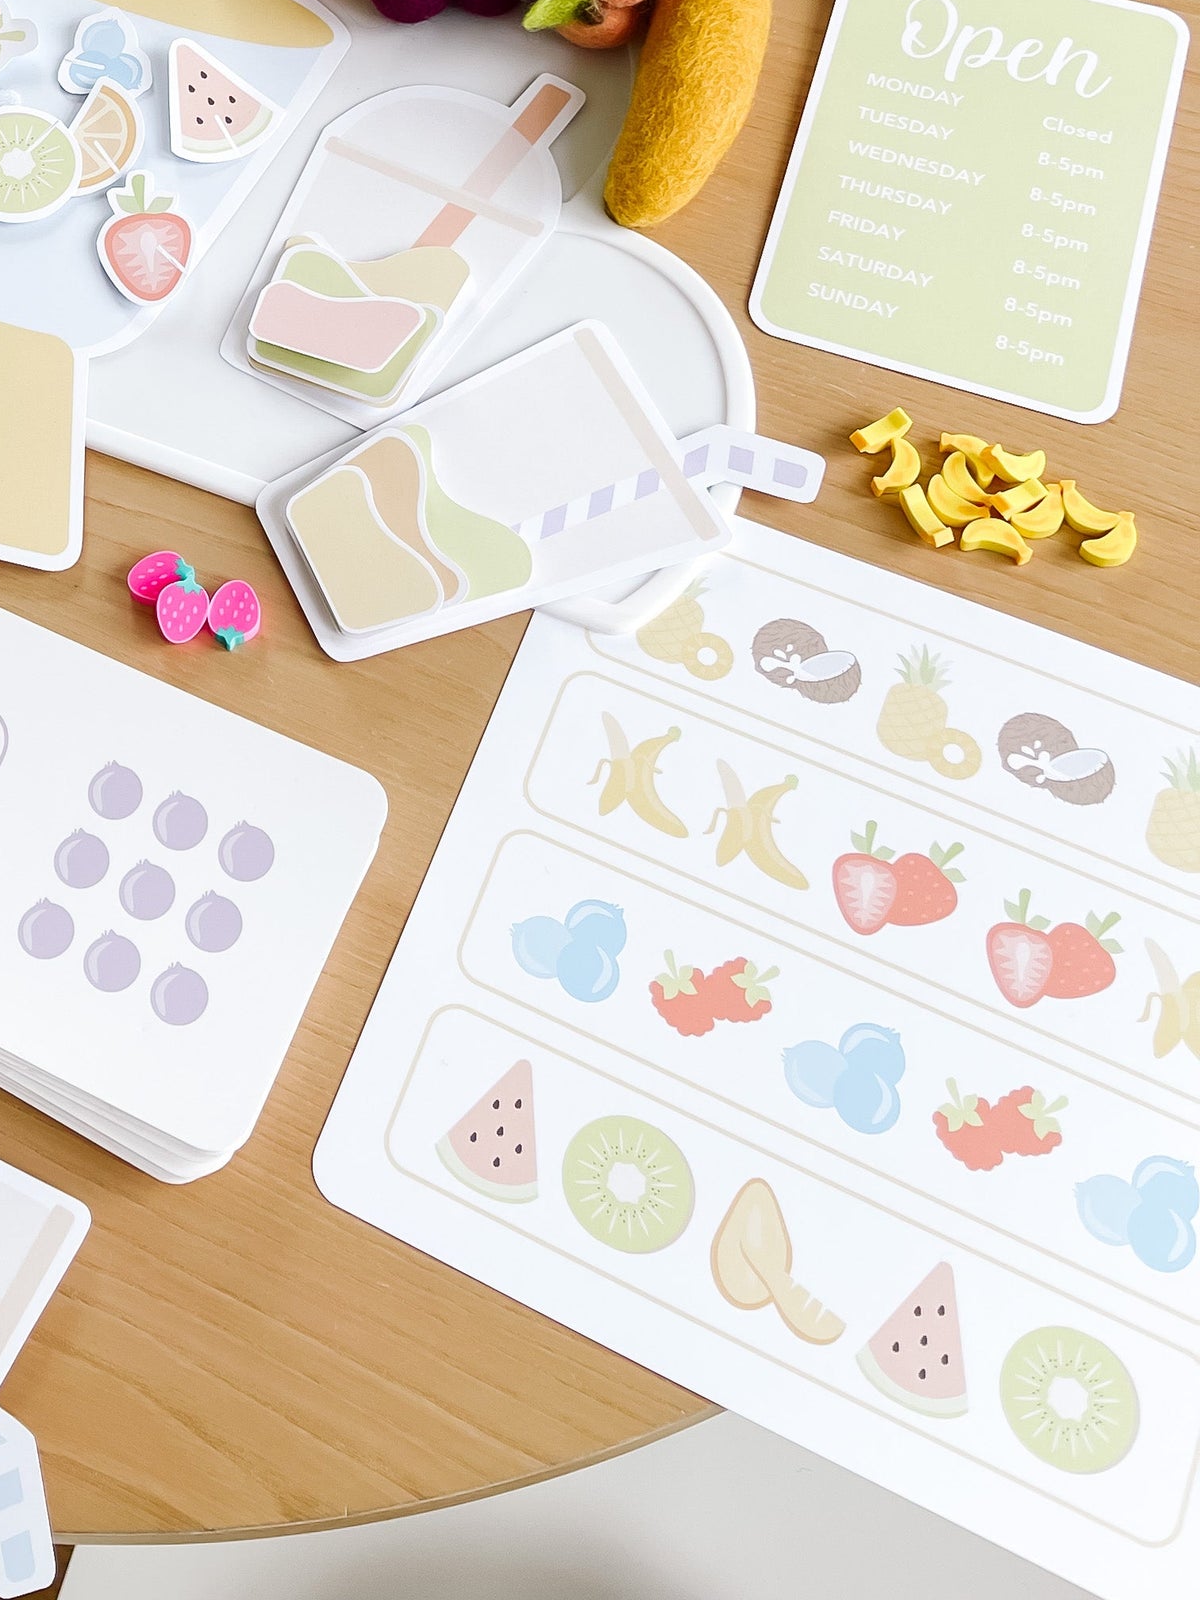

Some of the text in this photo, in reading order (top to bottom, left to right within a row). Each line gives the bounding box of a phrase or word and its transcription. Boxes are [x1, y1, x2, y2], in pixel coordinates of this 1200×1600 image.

[857, 105, 1105, 182] TUESDAY 8-5pm
[866, 72, 1113, 145] MONDAY Closed
[838, 174, 1090, 254] THURSDAY 8-5pm
[848, 139, 1097, 217] WEDNESDAY 8-5pm
[817, 245, 1074, 328] SATURDAY 8-5pm
[827, 209, 1081, 291] FRIDAY 8-5pm
[806, 282, 1065, 367] SUNDAY 8-5pm
